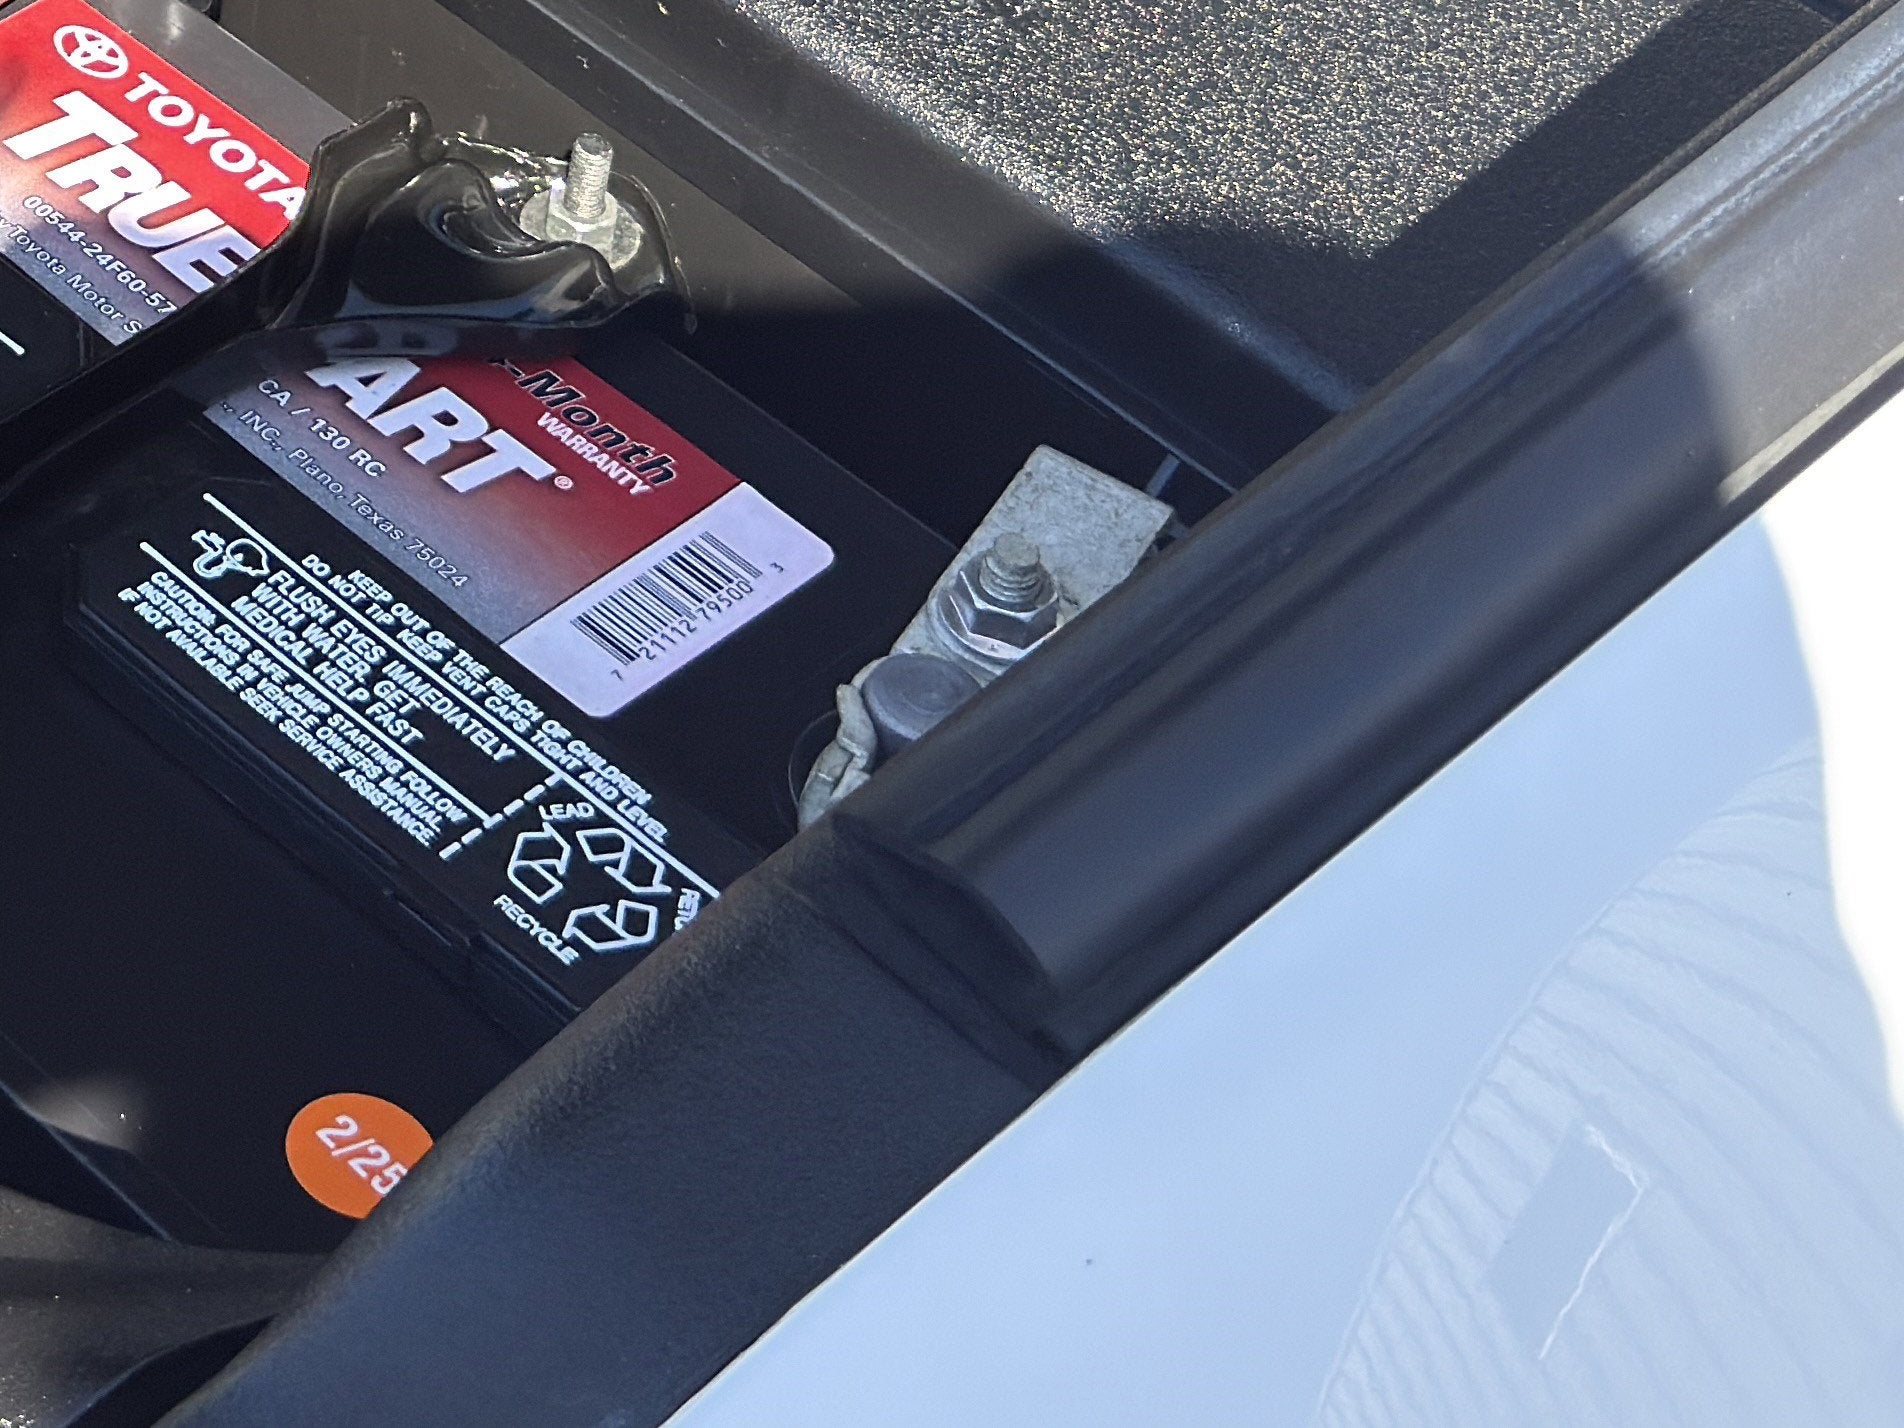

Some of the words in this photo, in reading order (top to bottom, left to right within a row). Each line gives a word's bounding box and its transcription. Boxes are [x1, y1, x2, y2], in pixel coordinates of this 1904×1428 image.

[2, 90, 262, 294] TRUE
[124, 72, 306, 220] TOYOTA
[8, 225, 68, 278] Toyota
[66, 274, 124, 321] Motor
[22, 195, 177, 314] 00544-24F60-57
[259, 380, 291, 407] CA
[309, 418, 350, 450] 130
[348, 448, 387, 478] RC
[537, 411, 652, 496] WARRANTY
[288, 448, 347, 500] Plano,
[348, 493, 407, 542] Texas
[406, 538, 471, 588] 75024
[118, 587, 141, 602] IF
[134, 601, 172, 630] NOT
[166, 629, 245, 692] AVAILABLE
[240, 688, 284, 723] SEEK
[278, 718, 345, 773] SERVICE
[136, 581, 240, 667] INSTRUCTIONS
[236, 664, 259, 681] IN
[257, 677, 320, 729] VEHICLE
[316, 727, 383, 780] OWNERS
[231, 595, 314, 666] MEDICAL
[313, 661, 370, 702] HELP
[366, 702, 425, 745] FAST
[252, 583, 305, 626] WITH
[373, 680, 421, 715] GET
[267, 570, 336, 624] FLUSH
[330, 619, 387, 663] EYES
[382, 659, 516, 761] IMMEDIATELY
[348, 570, 394, 604] KEEP
[391, 601, 430, 633] OUT
[426, 630, 456, 652] OF
[453, 649, 490, 679] THE
[486, 676, 544, 721] REACH
[542, 718, 572, 740] OF
[567, 739, 653, 806] CHILDREN
[610, 669, 625, 682] 7
[639, 618, 697, 661] 21112
[696, 580, 754, 622] 79500
[769, 562, 785, 574] 3
[215, 623, 251, 652] FOR
[247, 649, 291, 685] SAFE
[286, 683, 331, 714] JUMP
[327, 713, 404, 775] STARTING
[400, 770, 468, 823] FOLLOW
[301, 554, 331, 578] DO
[328, 574, 367, 605] NOT
[364, 602, 395, 626] TIP
[397, 629, 443, 662] KEEP
[441, 660, 487, 696] VENT
[484, 695, 531, 734] CAPS
[530, 729, 583, 770] TIGHT
[579, 771, 619, 802] AND
[617, 798, 669, 845] LEVEL
[538, 802, 596, 821] LEAD
[493, 894, 580, 965] RECYCLE
[315, 1114, 408, 1195] 2/25
